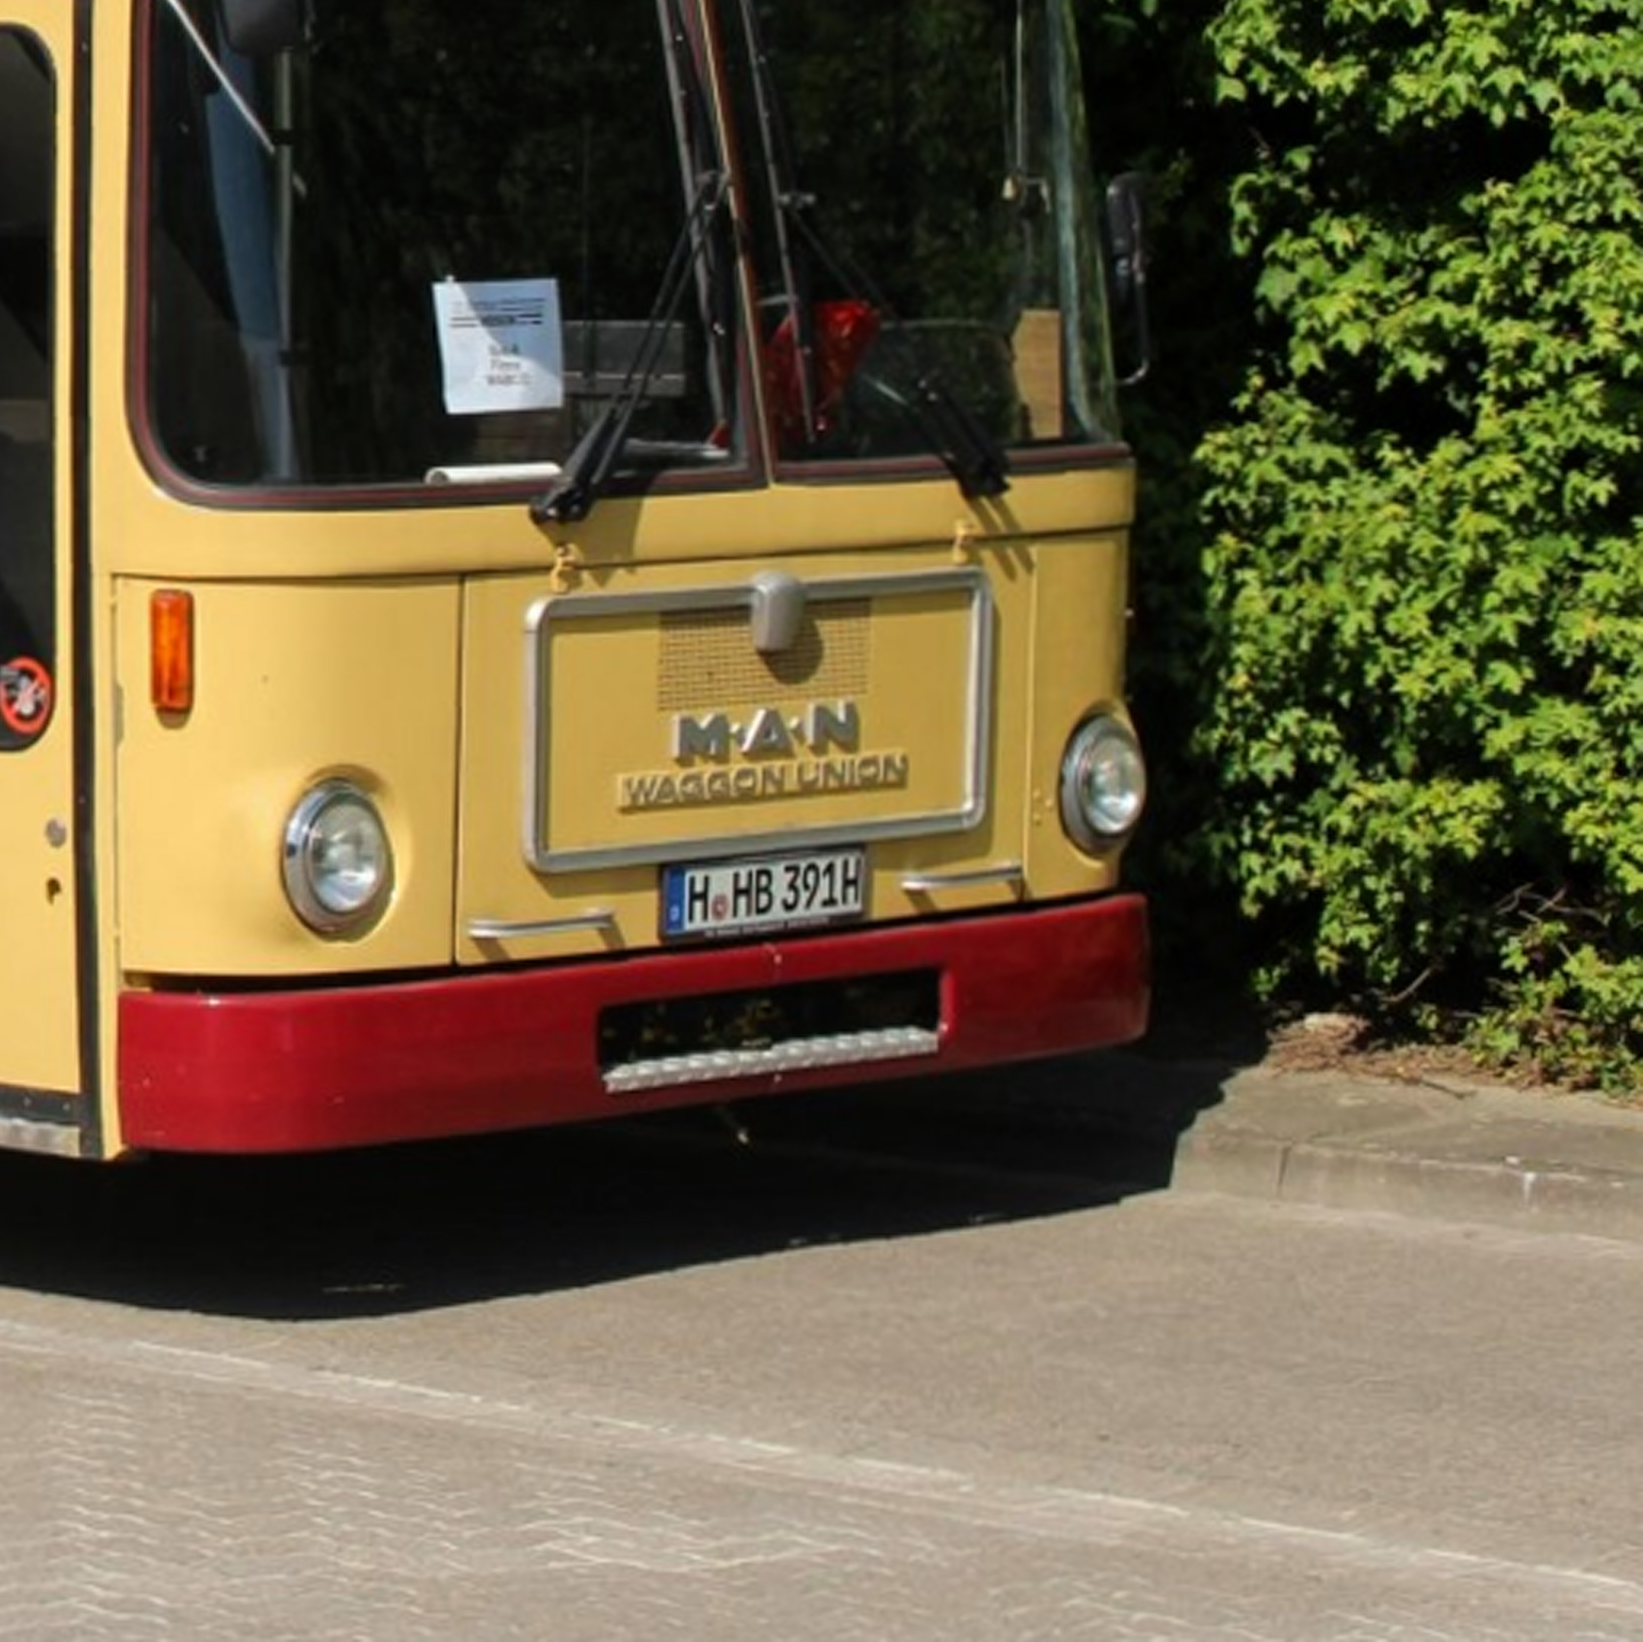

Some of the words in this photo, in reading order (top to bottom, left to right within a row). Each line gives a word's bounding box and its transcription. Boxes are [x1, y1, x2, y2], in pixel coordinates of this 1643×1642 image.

[622, 765, 787, 806] WAGGON
[795, 754, 908, 792] UNION
[688, 874, 709, 922] H
[733, 868, 774, 919] HB
[781, 858, 862, 912] 391H
